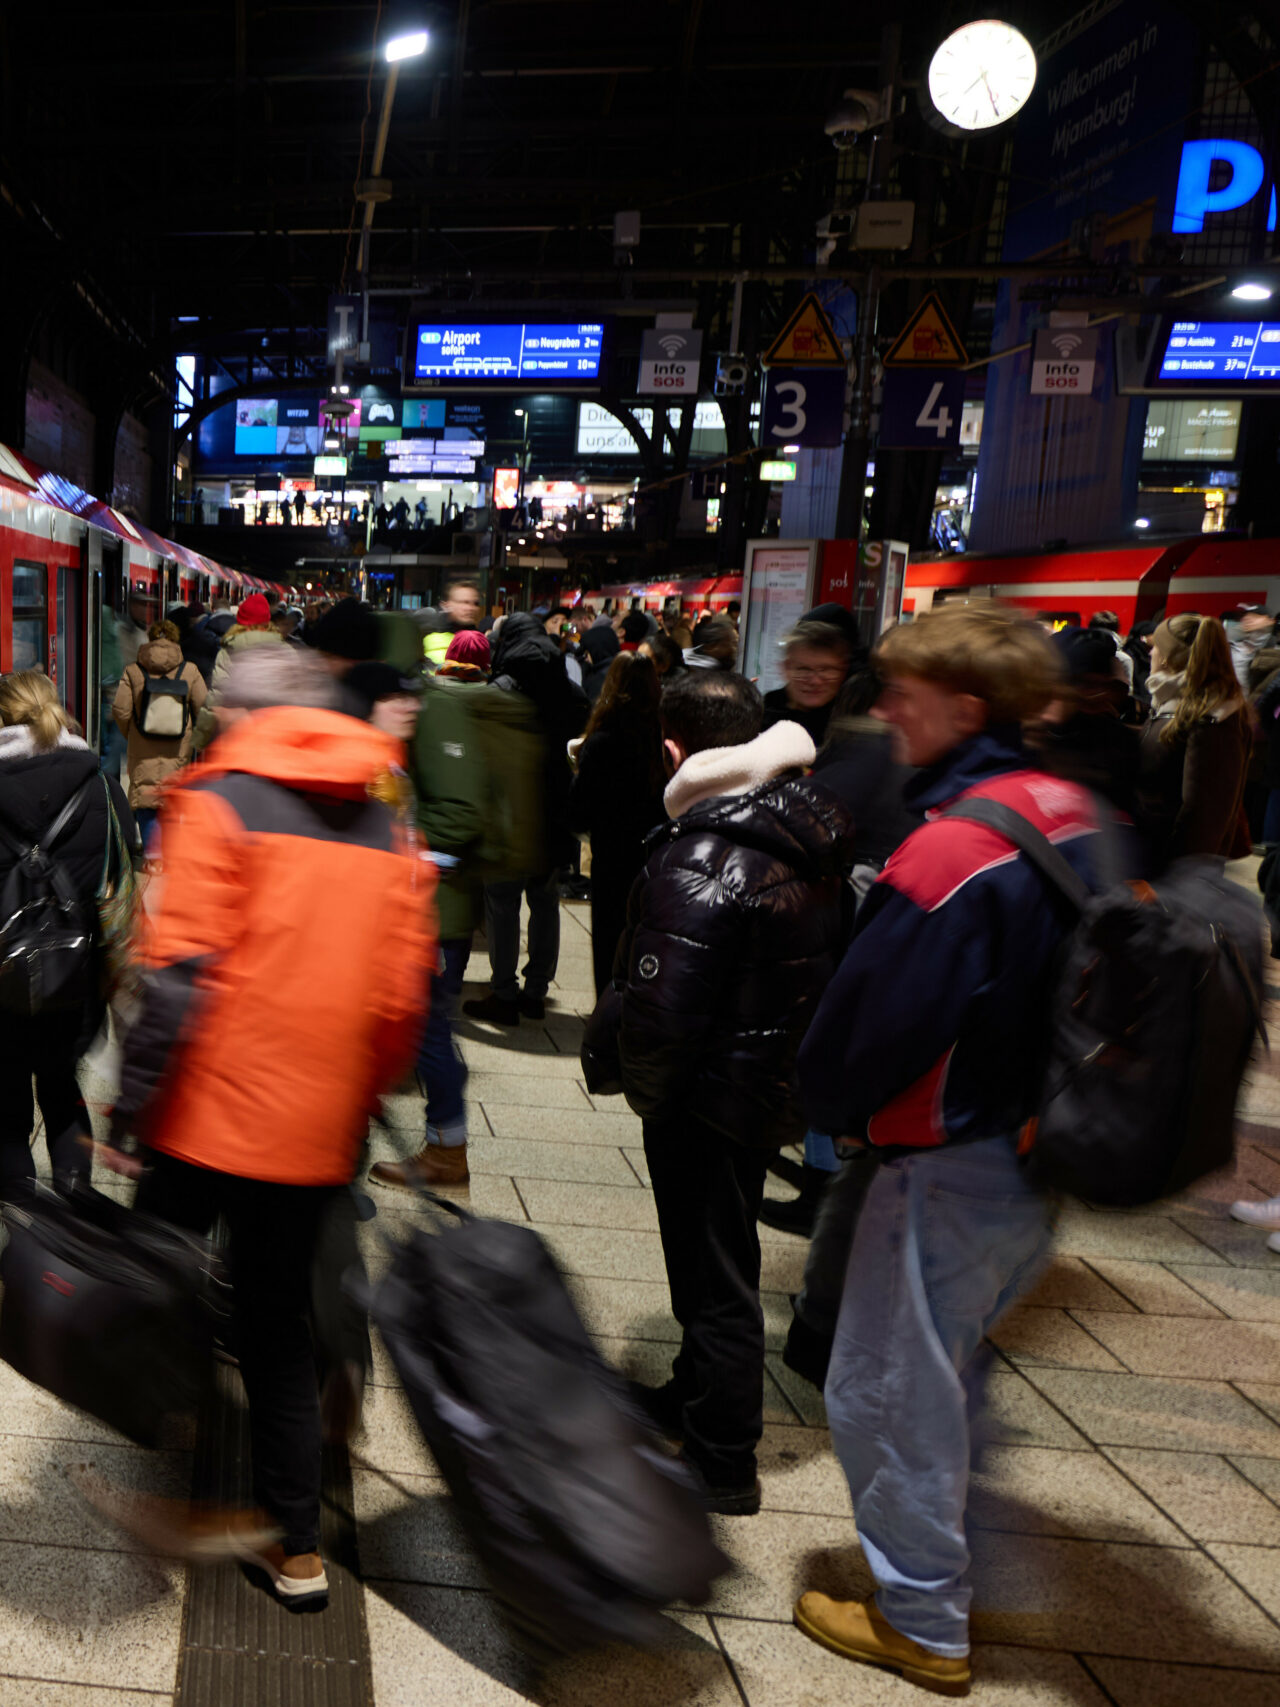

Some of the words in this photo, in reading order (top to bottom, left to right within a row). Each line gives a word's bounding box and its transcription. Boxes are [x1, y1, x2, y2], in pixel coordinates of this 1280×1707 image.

[1047, 38, 1139, 116] Willkommen
[1142, 20, 1159, 55] in
[1050, 73, 1138, 160] Mjamburg!
[1172, 139, 1277, 233] P
[442, 330, 480, 347] Airport
[540, 337, 580, 350] Neugraben
[584, 337, 590, 349] 2
[441, 345, 466, 356] sofort
[577, 359, 588, 370] 10
[654, 363, 686, 375] Info
[1046, 363, 1079, 375] Info
[653, 376, 685, 387] SOS
[1045, 376, 1078, 389] SOS
[587, 408, 613, 422] Die
[771, 380, 807, 437] 3
[915, 382, 953, 438] 4
[586, 434, 615, 448] uns
[465, 510, 478, 530] 3
[511, 510, 524, 530] 4
